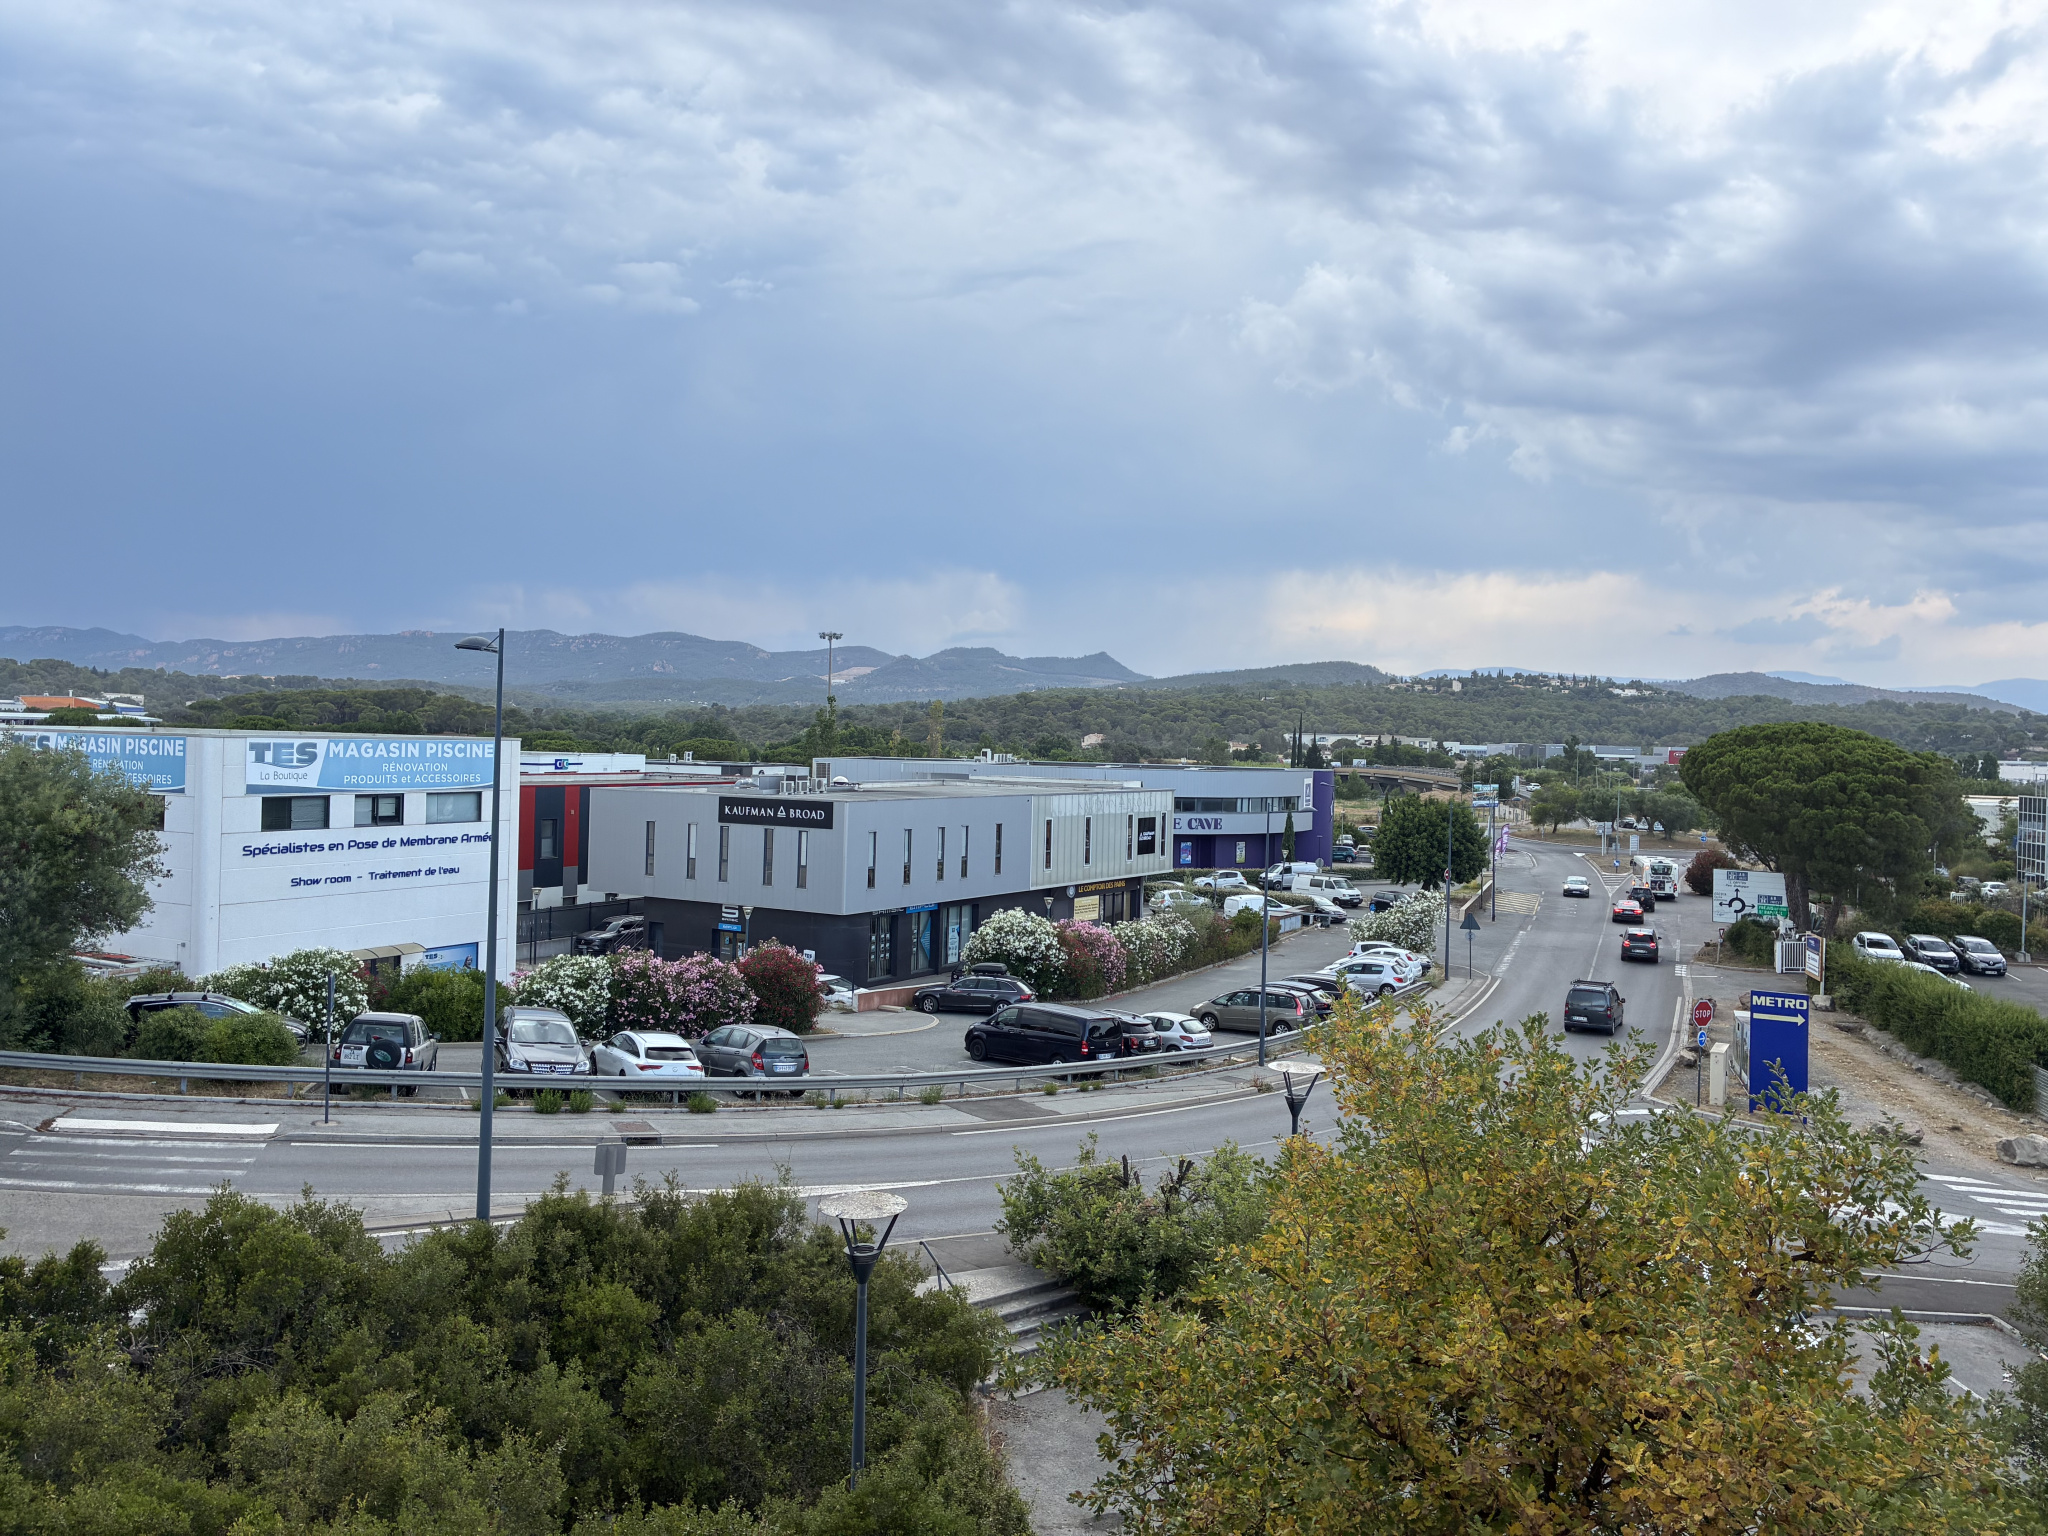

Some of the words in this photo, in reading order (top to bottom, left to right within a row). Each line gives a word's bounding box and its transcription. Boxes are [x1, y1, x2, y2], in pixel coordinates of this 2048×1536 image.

[57, 735, 121, 754] MAGASIN
[126, 738, 184, 756] PISCINE
[329, 742, 424, 758] MAGASIN
[427, 742, 494, 758] PISCINE
[249, 742, 318, 766] TES
[382, 762, 448, 772] RÉNOVATION
[260, 771, 271, 781] La
[273, 770, 308, 782] Boutique
[344, 774, 398, 784] PRODUITS
[401, 775, 411, 783] et
[414, 773, 481, 784] ACCESSOIRES
[724, 805, 774, 817] KAUFMAN
[789, 808, 825, 820] BROAD
[1187, 817, 1222, 830] CAVE
[242, 842, 325, 858] Spécialistes
[328, 842, 344, 851] en
[347, 839, 379, 851] Pose
[381, 837, 396, 848] de
[400, 834, 458, 847] Membrane
[290, 877, 322, 887] Show
[324, 874, 352, 884] room
[368, 868, 422, 881] Traitement
[424, 867, 436, 877] de
[438, 866, 460, 875] l'eau
[1752, 995, 1808, 1010] METRO
[1695, 1009, 1711, 1019] STOP
